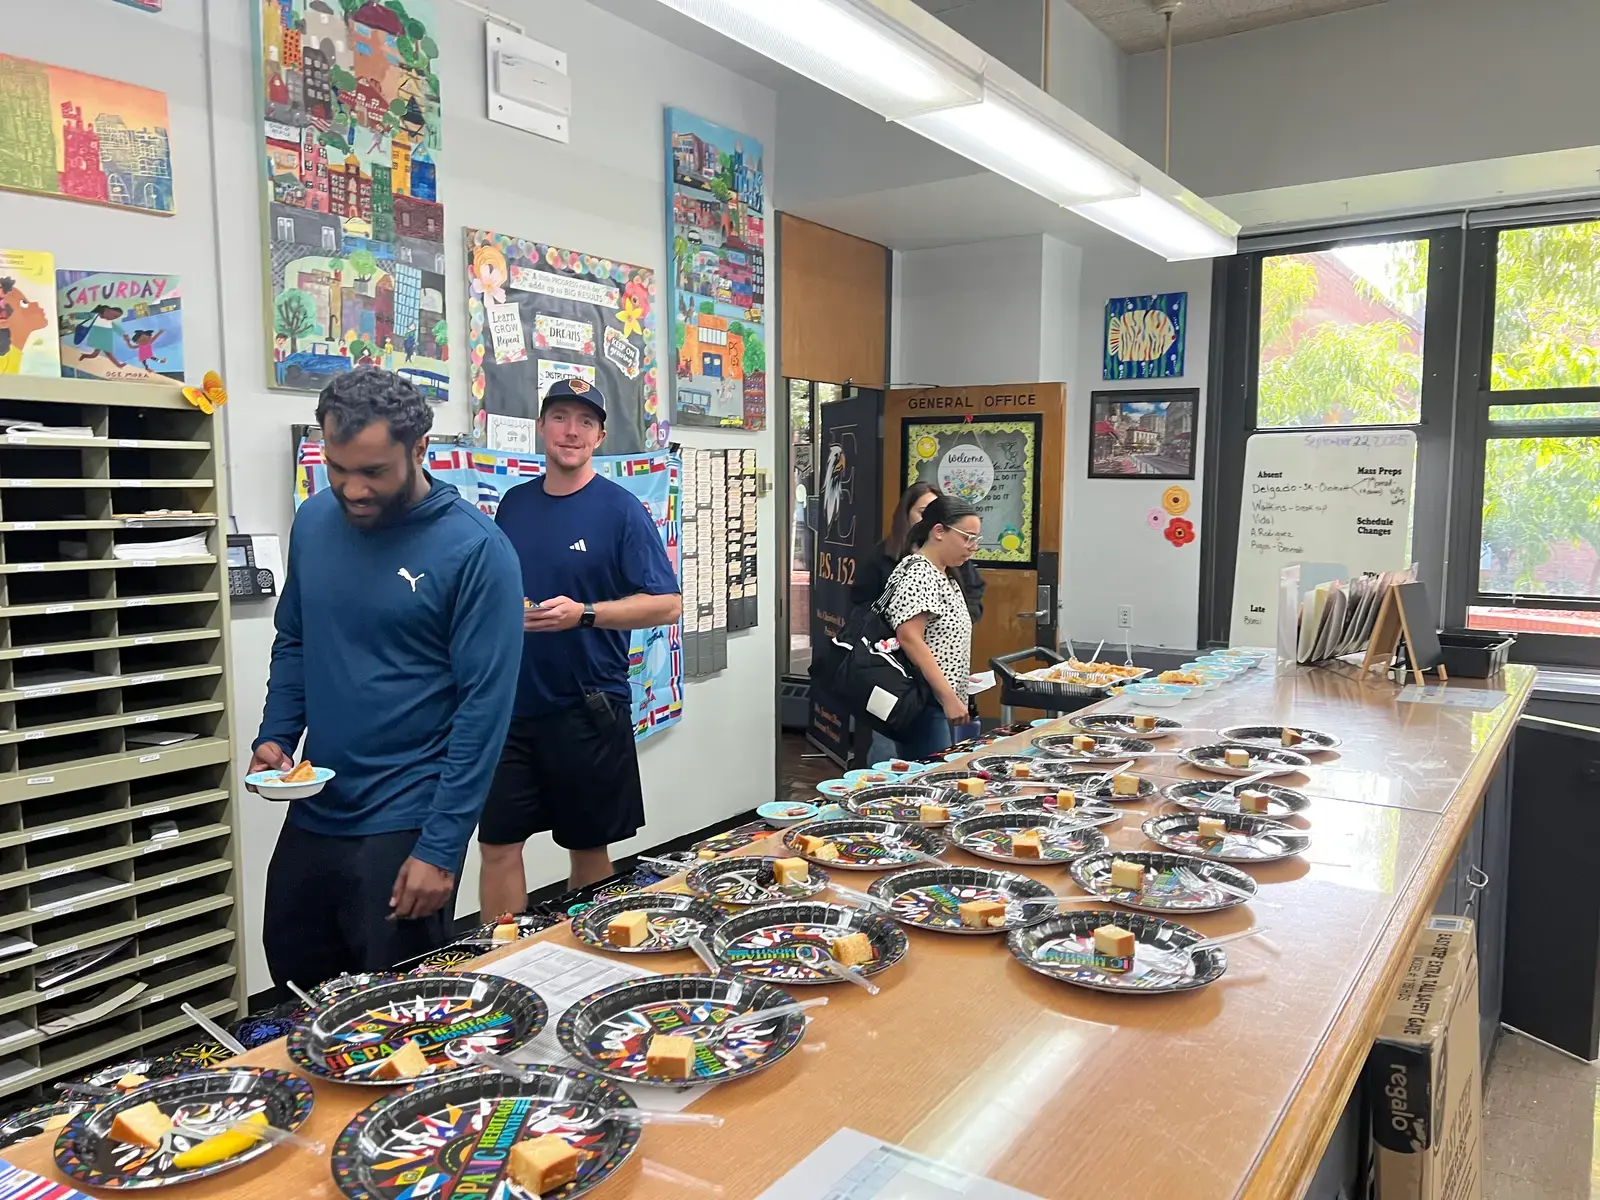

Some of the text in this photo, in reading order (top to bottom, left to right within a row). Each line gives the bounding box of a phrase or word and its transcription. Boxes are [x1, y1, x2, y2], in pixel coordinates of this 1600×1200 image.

[64, 278, 167, 309] SATURDAY
[564, 288, 577, 298] BIG
[577, 291, 604, 303] RESULTS
[492, 311, 516, 323] Learn
[494, 323, 518, 334] GROW
[549, 327, 581, 342] DREAMS
[496, 334, 520, 348] Repeat
[611, 337, 635, 359] KEEP ON
[908, 394, 1036, 410] GENERAL OFFICE
[1303, 434, 1351, 451] September
[948, 452, 985, 464] Welcome
[1257, 471, 1283, 479] Absent
[1357, 466, 1403, 477] Mass Preps
[1356, 517, 1394, 526] Schedule
[1357, 526, 1392, 536] Changes
[836, 556, 856, 585] 152
[1250, 605, 1266, 614] Late
[1403, 933, 1453, 1036] EASY STEP EXTRA TALL SAFETY GATE
[428, 1010, 506, 1038] HERITAGE
[432, 1022, 486, 1043] MONTH
[323, 1033, 431, 1072] HISPANC
[1385, 1064, 1415, 1132] regalo
[477, 1096, 518, 1148] HERITAGE
[494, 1112, 521, 1156] MONTH
